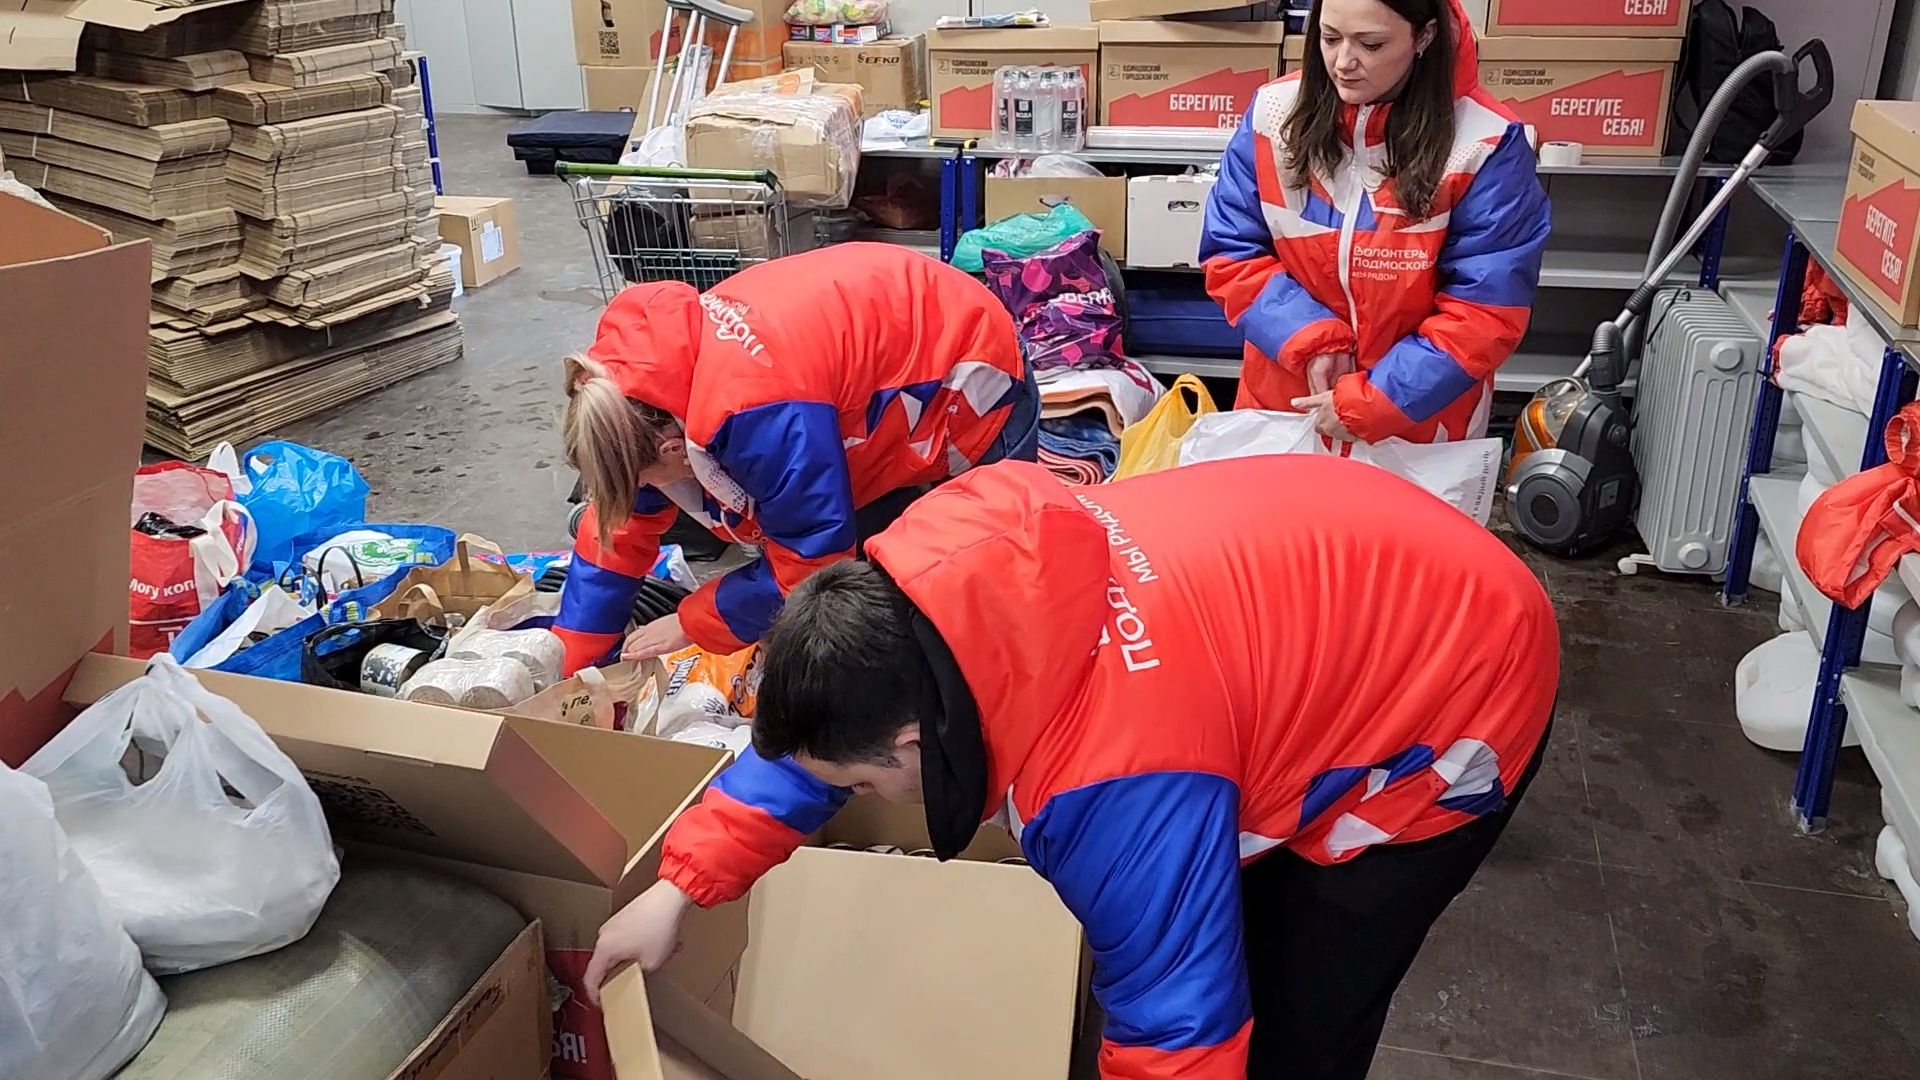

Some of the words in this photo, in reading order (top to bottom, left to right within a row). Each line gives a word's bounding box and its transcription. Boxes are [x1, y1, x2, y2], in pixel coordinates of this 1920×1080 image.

[1624, 0, 1668, 15] СЕБЯ!
[1170, 93, 1234, 111] БЕРЕГИТЕ
[1551, 98, 1623, 117] БЕРЕГИТЕ
[1602, 118, 1645, 136] СЕБЯ!
[1865, 204, 1898, 248] БЕРЕГИТЕ
[1119, 545, 1160, 584] МЫ
